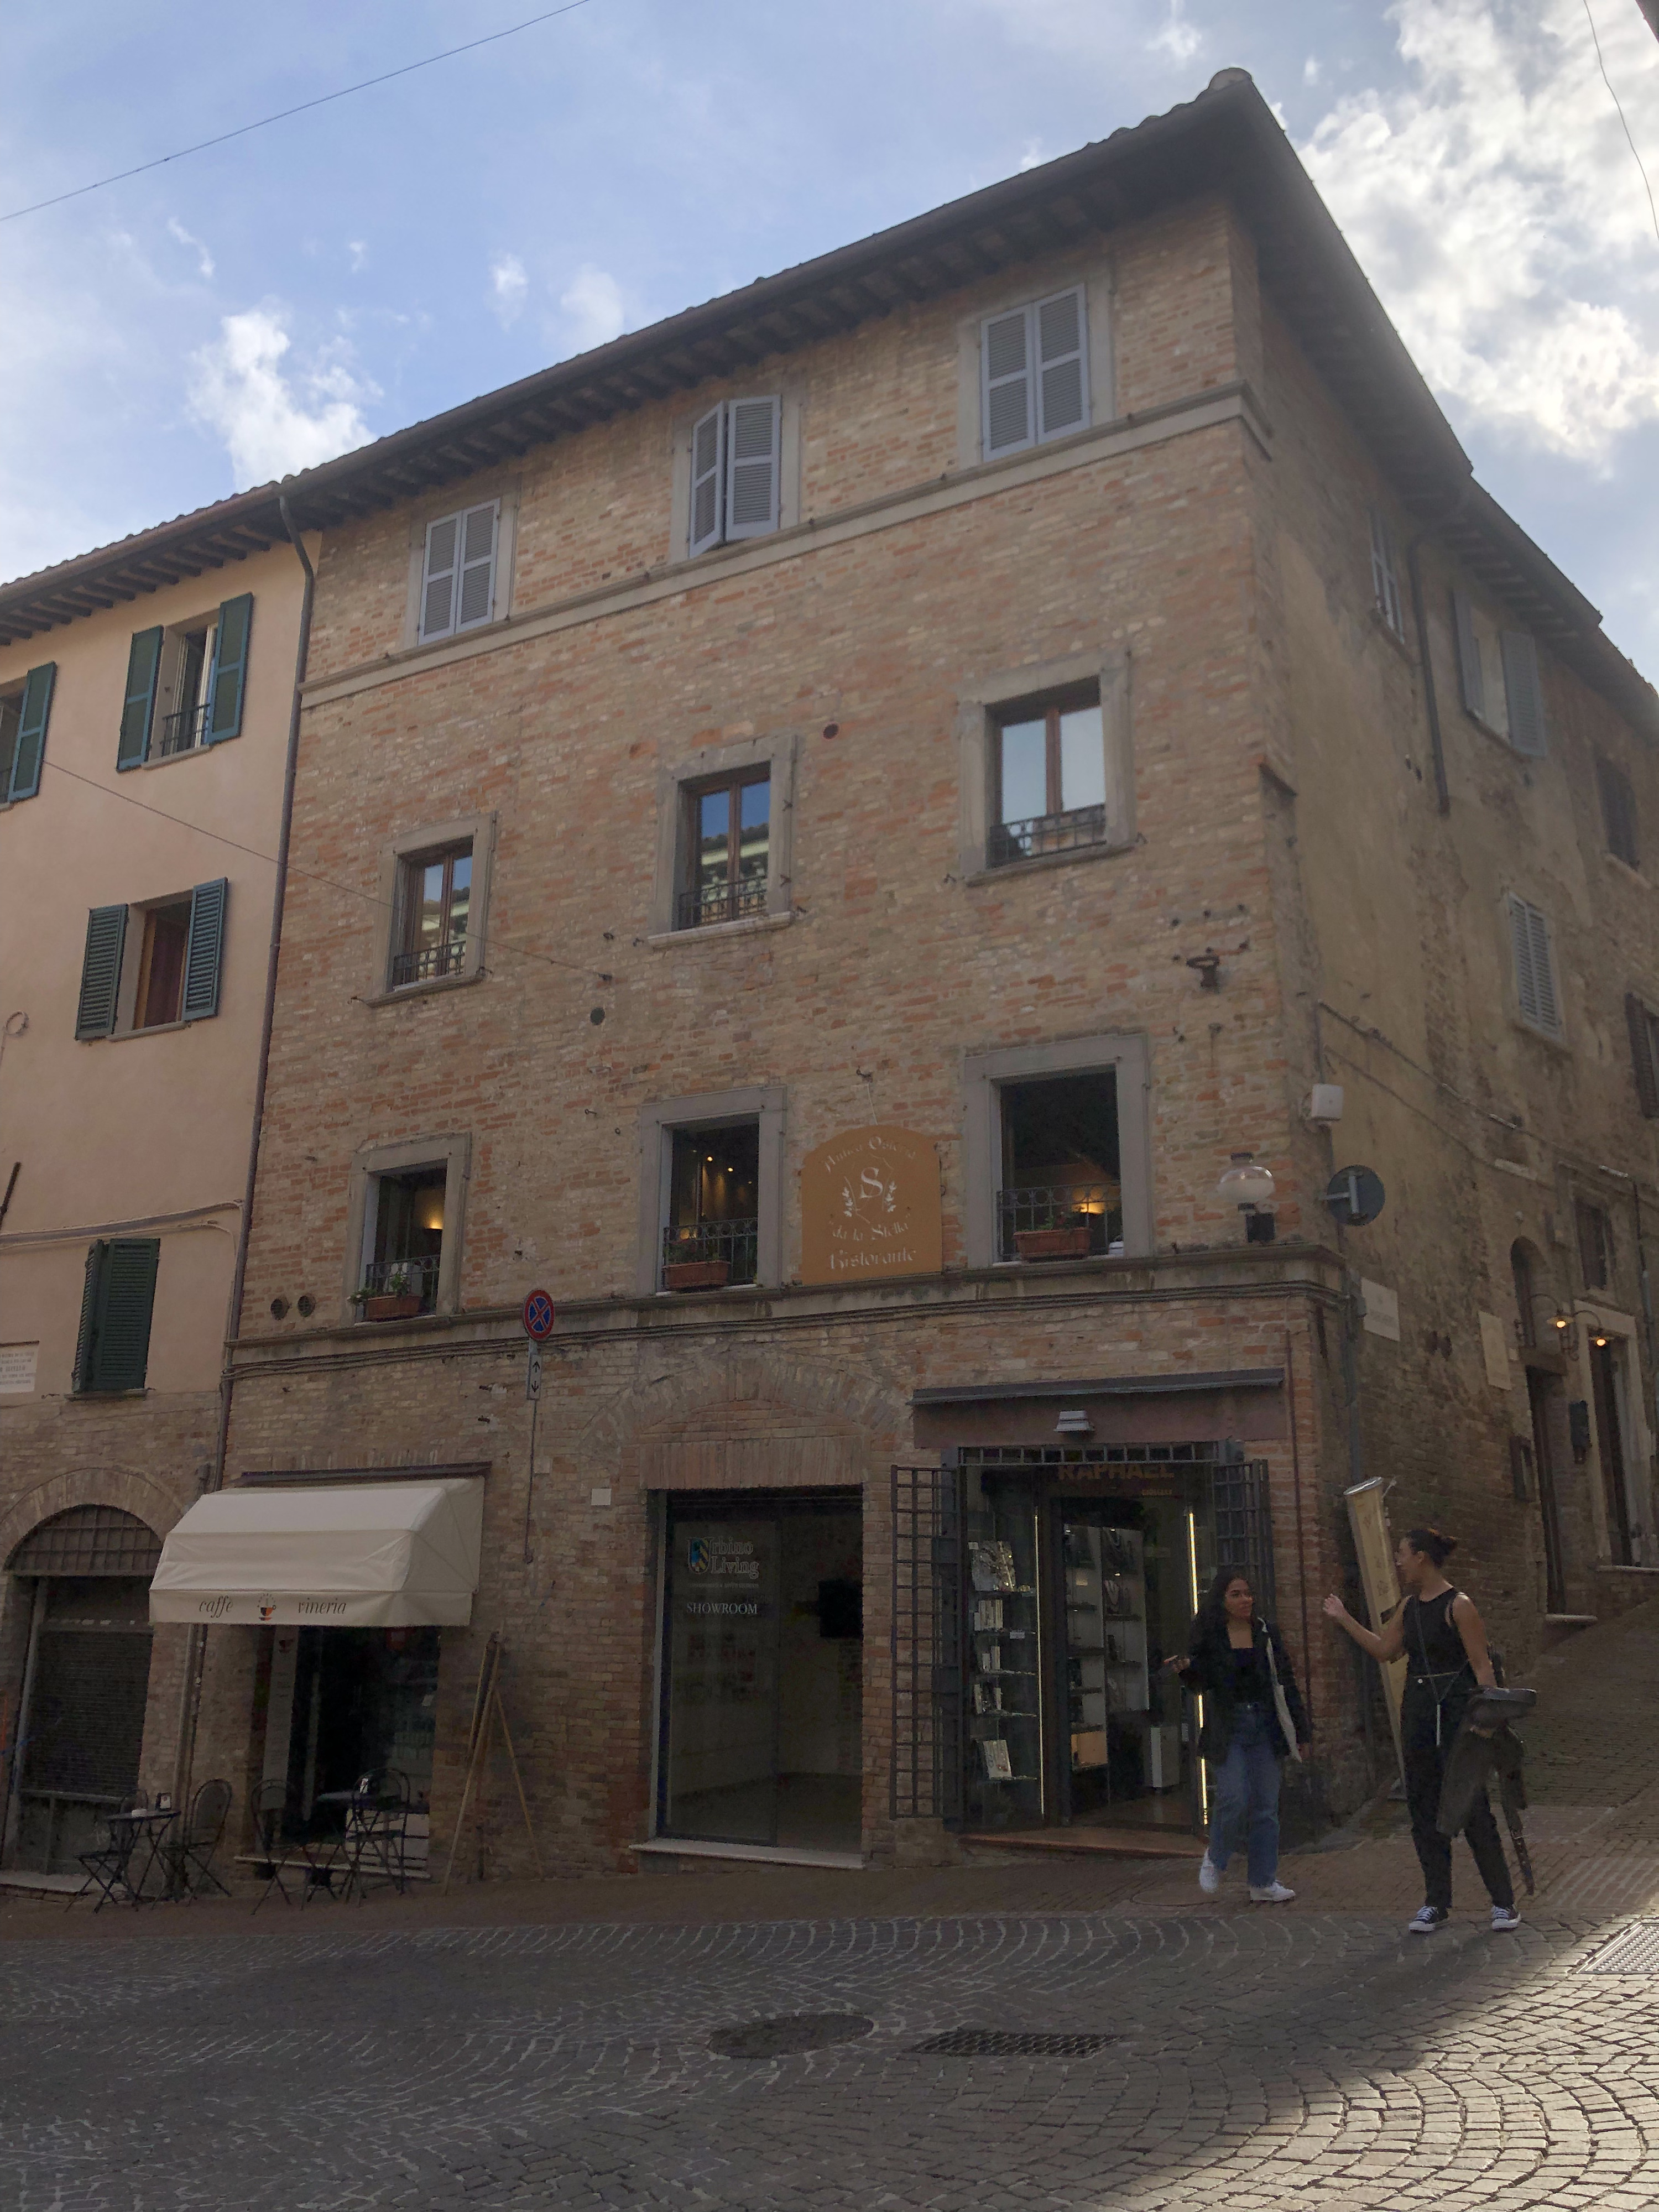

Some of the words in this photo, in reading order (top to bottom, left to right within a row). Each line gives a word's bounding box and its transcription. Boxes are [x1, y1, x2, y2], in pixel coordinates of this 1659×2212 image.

[829, 1247, 916, 1270] Ristorante
[710, 1556, 760, 1580] Living
[298, 1598, 347, 1614] vineria
[686, 1601, 758, 1615] SHOWROOM
